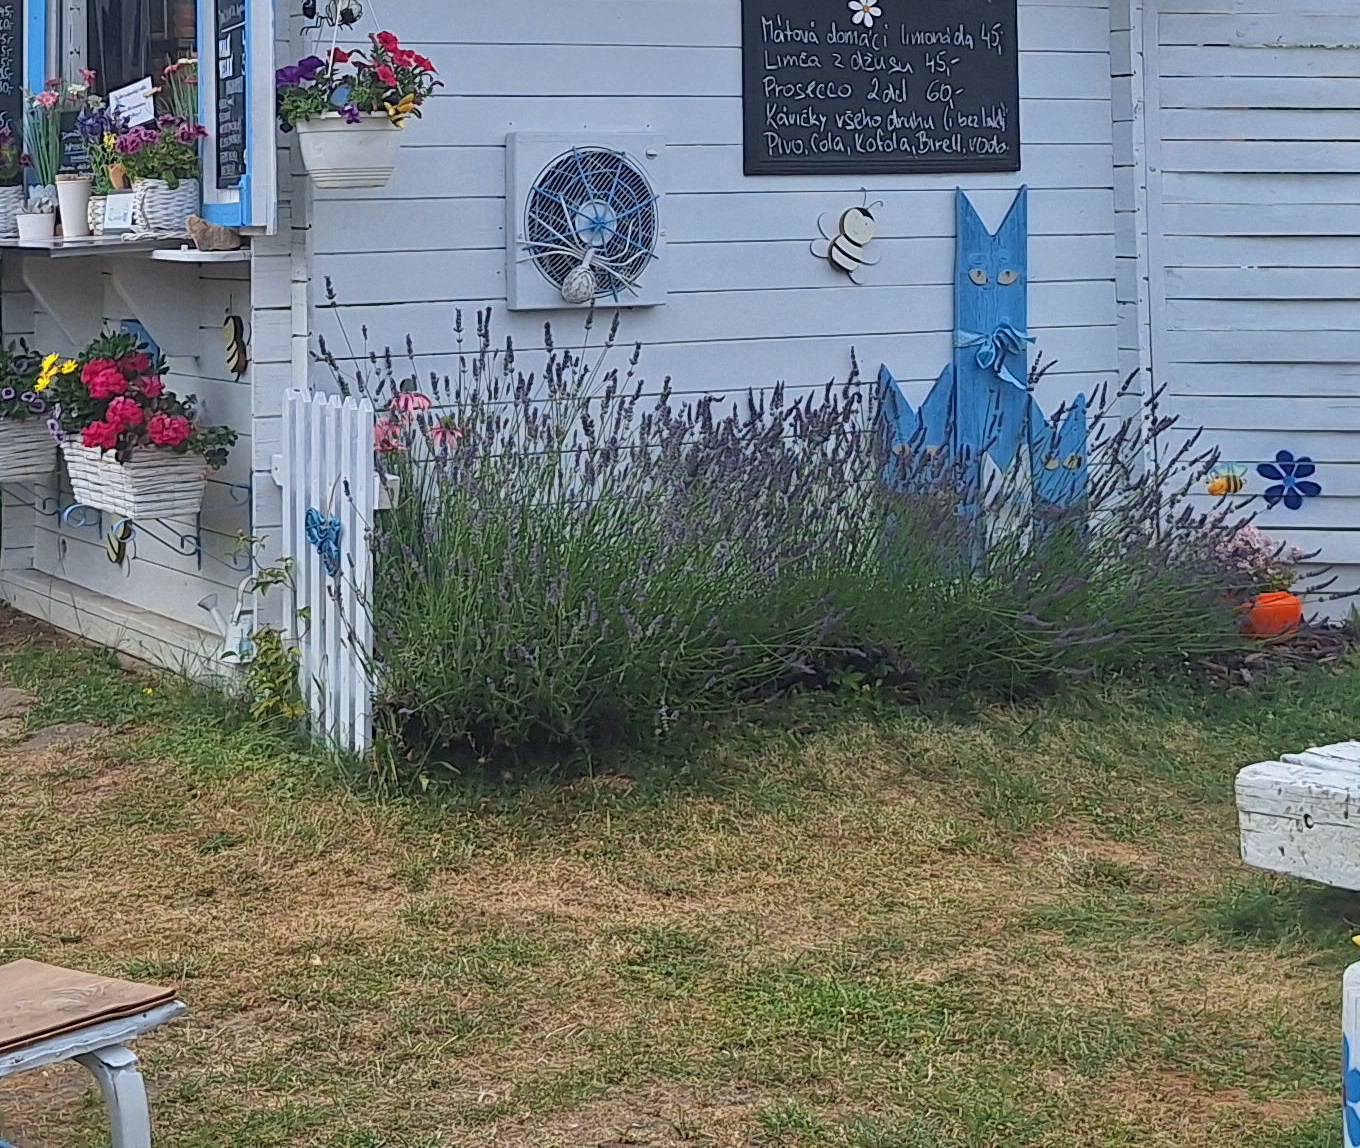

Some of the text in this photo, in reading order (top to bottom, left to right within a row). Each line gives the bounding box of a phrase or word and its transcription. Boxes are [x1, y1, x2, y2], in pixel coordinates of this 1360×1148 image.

[762, 76, 852, 100] Prosecco
[765, 103, 827, 130] Kávičky
[836, 108, 882, 130] všeho
